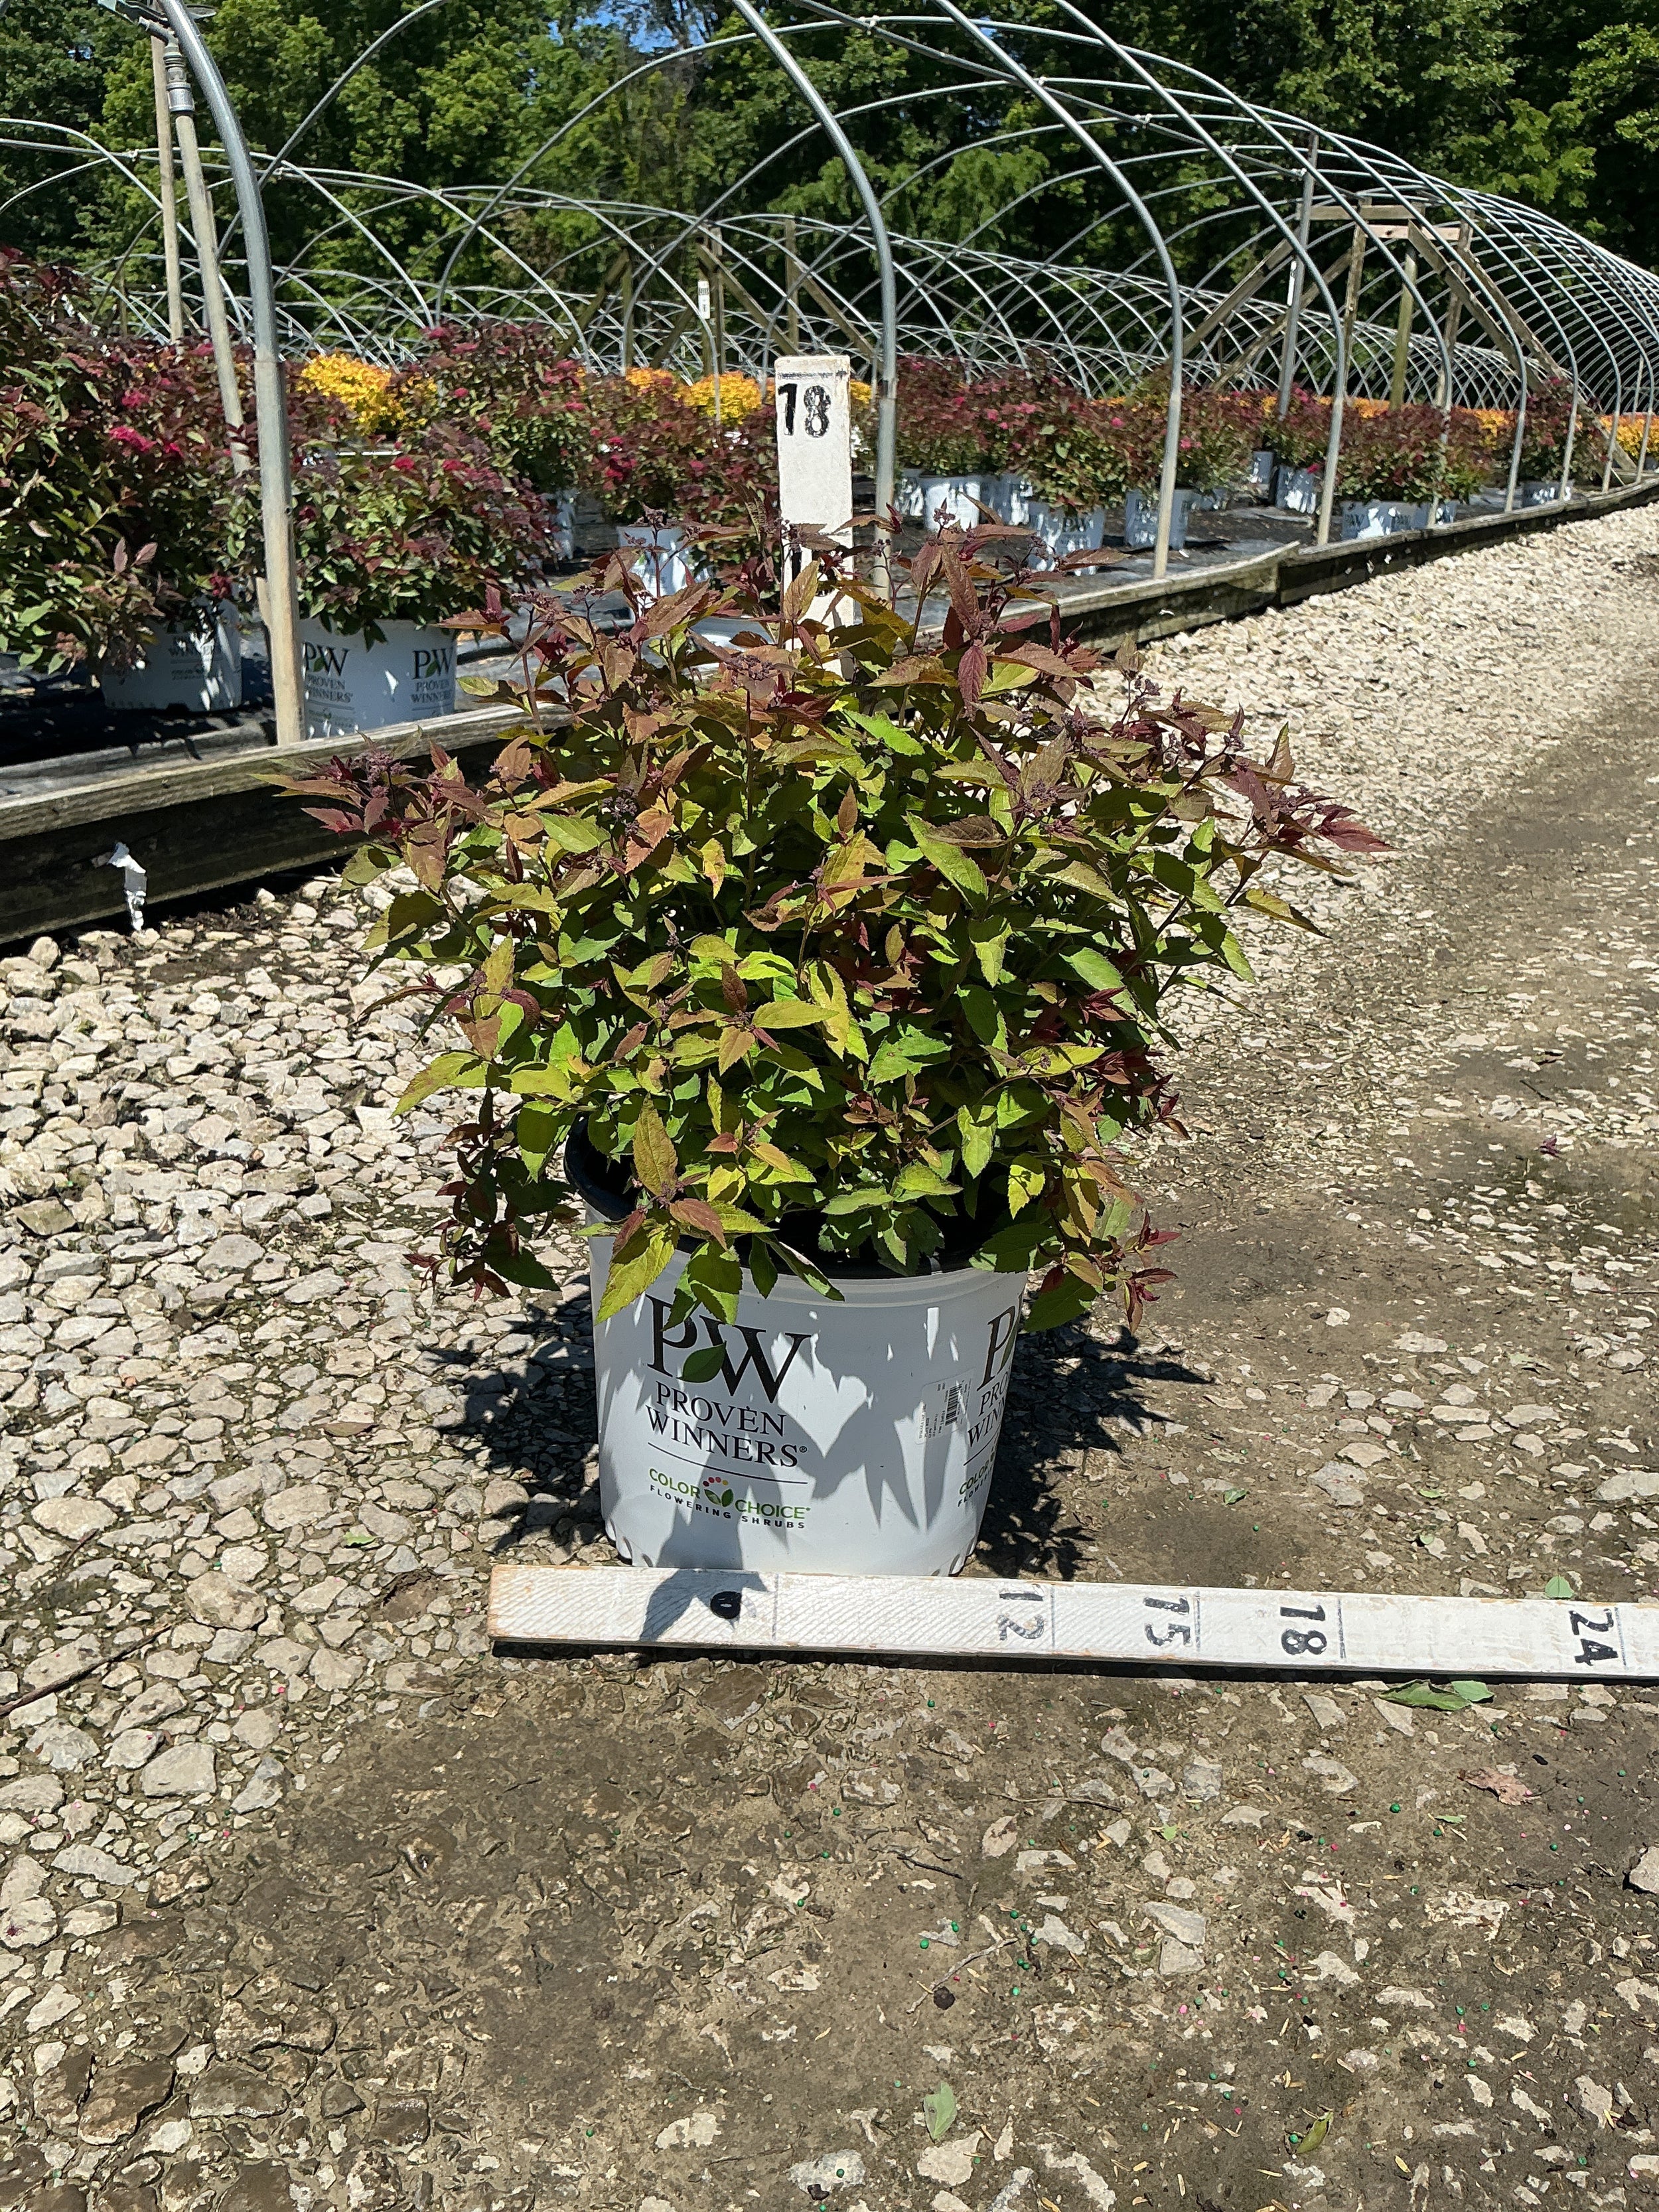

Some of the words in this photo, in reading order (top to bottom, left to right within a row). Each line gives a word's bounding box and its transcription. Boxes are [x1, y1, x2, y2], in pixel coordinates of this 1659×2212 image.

[778, 383, 831, 438] 18
[412, 646, 454, 680] PW
[646, 1294, 811, 1404] PW
[656, 1380, 787, 1437] PROVEN
[649, 1467, 701, 1499] COLOR
[650, 1484, 731, 1519] FLOWERING
[741, 1514, 805, 1529] SHRUBS
[997, 1584, 1045, 1640] 12
[1143, 1594, 1190, 1647] 15
[1280, 1605, 1327, 1655] 18
[1569, 1608, 1619, 1666] 24
